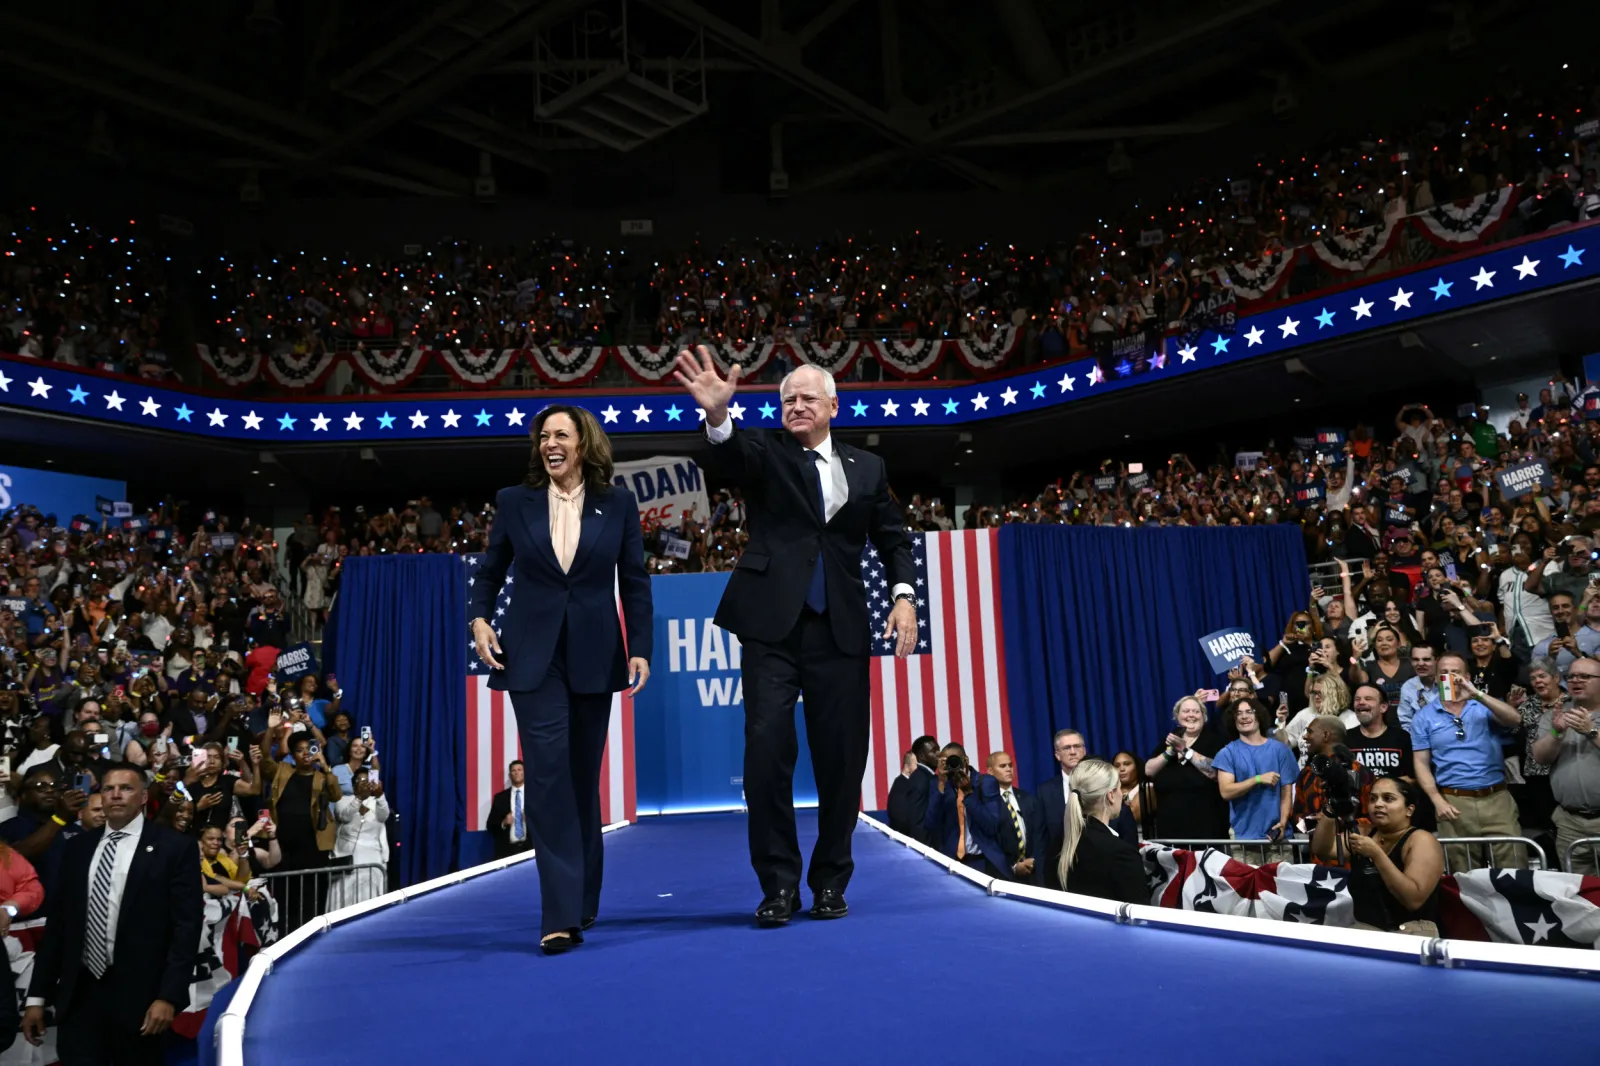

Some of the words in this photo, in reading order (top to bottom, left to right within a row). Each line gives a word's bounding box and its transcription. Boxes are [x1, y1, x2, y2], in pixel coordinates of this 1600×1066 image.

[1502, 463, 1544, 487] HARRIS
[1208, 633, 1255, 657] HARRIS
[277, 648, 309, 668] HARRIS
[1224, 648, 1255, 662] WALZ
[284, 662, 308, 675] WALZ
[1357, 752, 1400, 767] ARRIS
